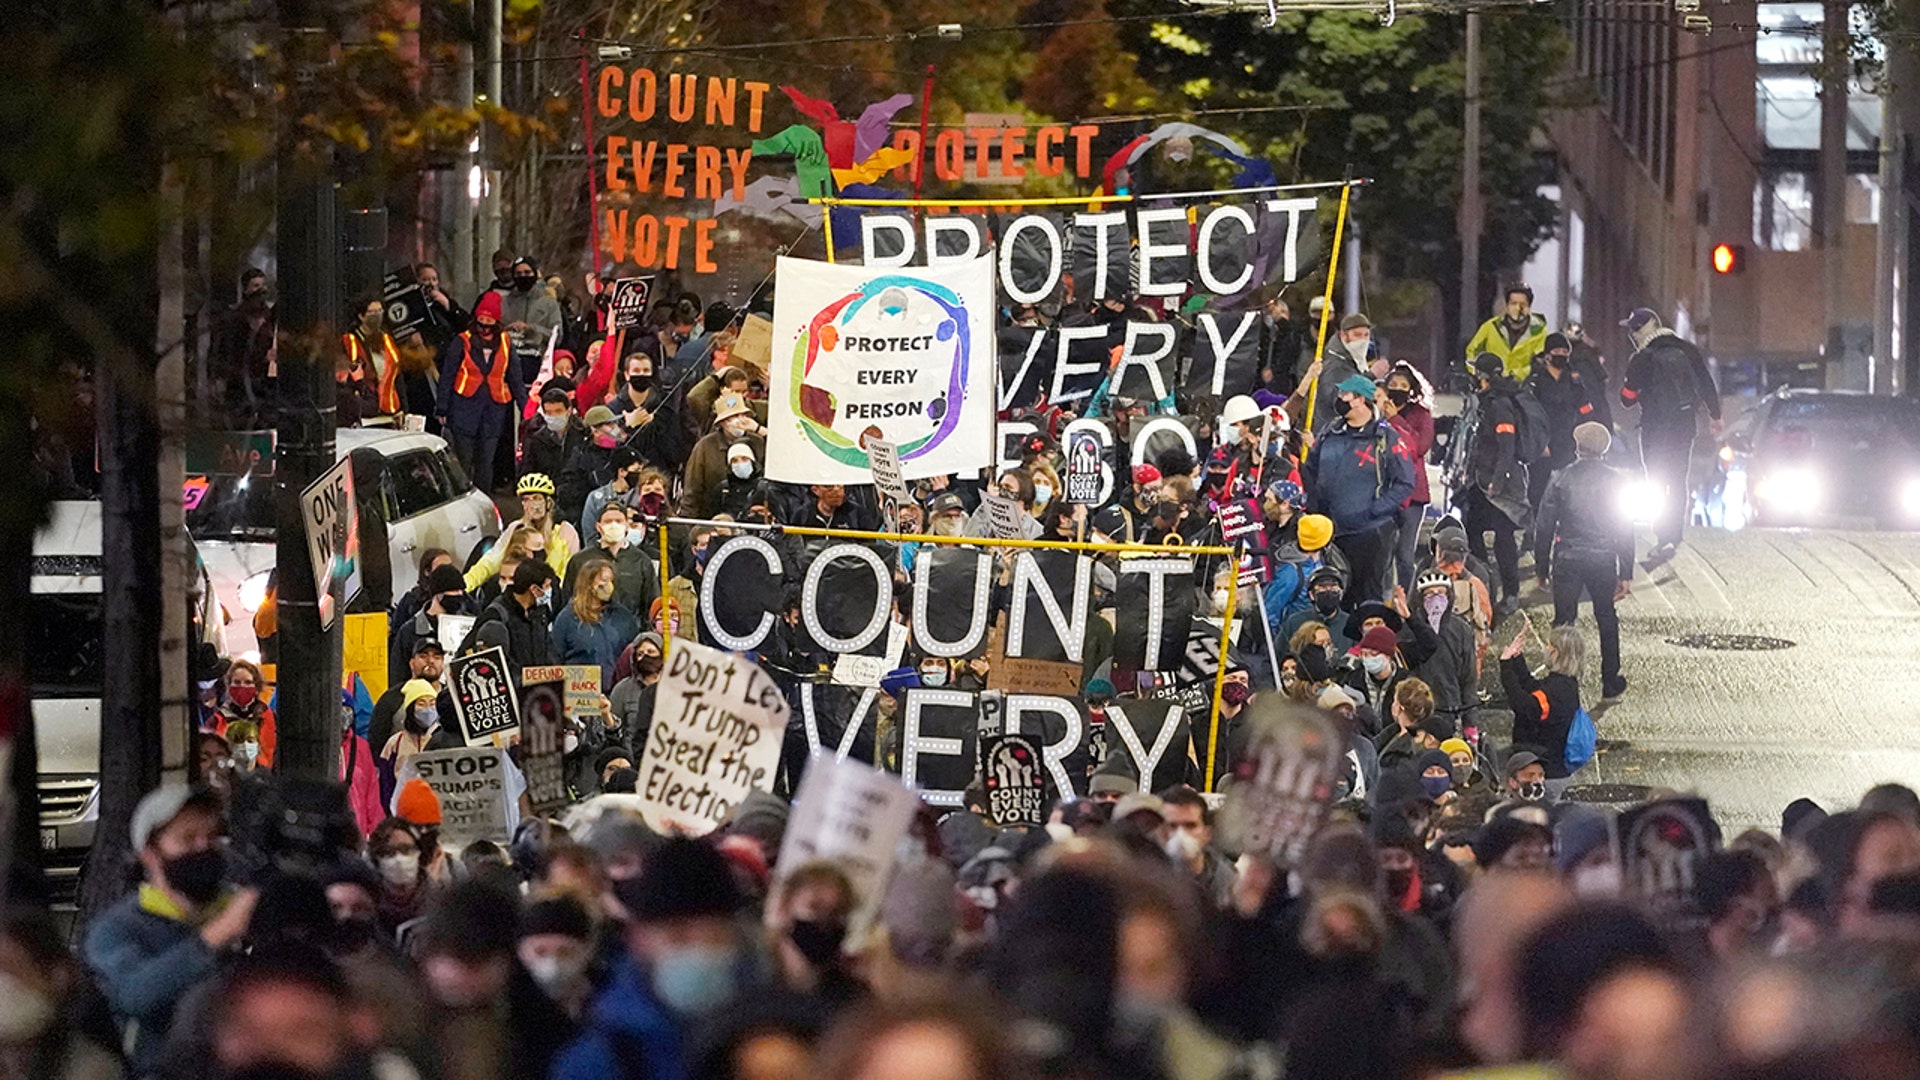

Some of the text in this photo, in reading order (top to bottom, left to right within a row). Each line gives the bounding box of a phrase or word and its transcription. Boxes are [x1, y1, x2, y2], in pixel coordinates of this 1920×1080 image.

[598, 66, 769, 132] COUNT
[606, 136, 752, 200] EVERY
[606, 209, 717, 273] VOTE
[845, 336, 933, 351] PROTECT
[997, 311, 1256, 411] VERY
[857, 369, 918, 384] EVERY
[845, 401, 923, 419] PERSON
[1070, 473, 1098, 481] COUNT
[1070, 481, 1097, 489] EVERY
[1070, 489, 1096, 499] VOTE
[701, 535, 1194, 670] COUNT
[525, 667, 564, 680] DEFUND
[466, 695, 506, 712] COUNT
[468, 703, 508, 722] EVERY
[471, 712, 511, 731] VOTE
[679, 691, 760, 751] Trump
[800, 682, 1184, 806] VERY
[651, 722, 766, 788] Steal the
[415, 755, 499, 778] STOP
[433, 778, 501, 794] RUMP'S
[645, 764, 729, 822] Electio
[990, 788, 1041, 800] COUNT
[991, 798, 1042, 811] EVERY
[992, 809, 1041, 824] VOTE
